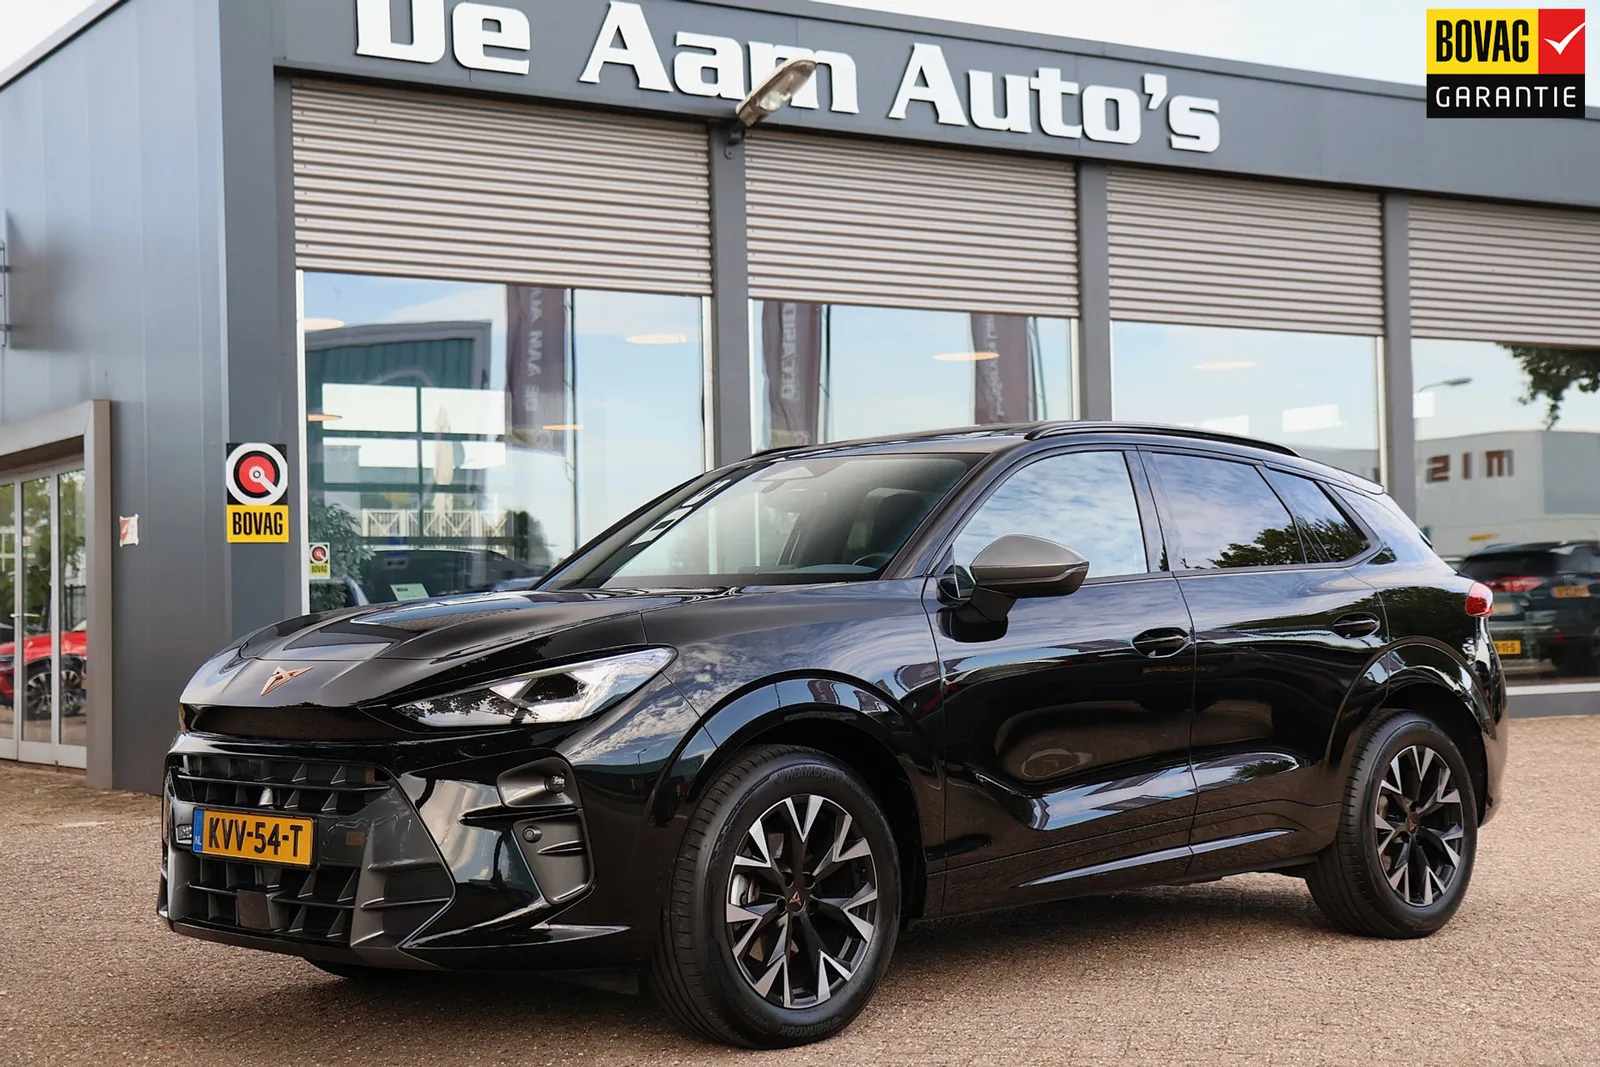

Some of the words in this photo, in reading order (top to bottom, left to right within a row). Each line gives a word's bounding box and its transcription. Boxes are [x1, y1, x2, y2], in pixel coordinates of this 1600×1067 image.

[356, 0, 531, 75] De
[579, 1, 860, 114] Aam
[888, 43, 1221, 153] Auto's
[232, 511, 283, 536] BOVAG
[311, 565, 328, 574] BOVAG
[208, 817, 303, 858] KVV-54-T
